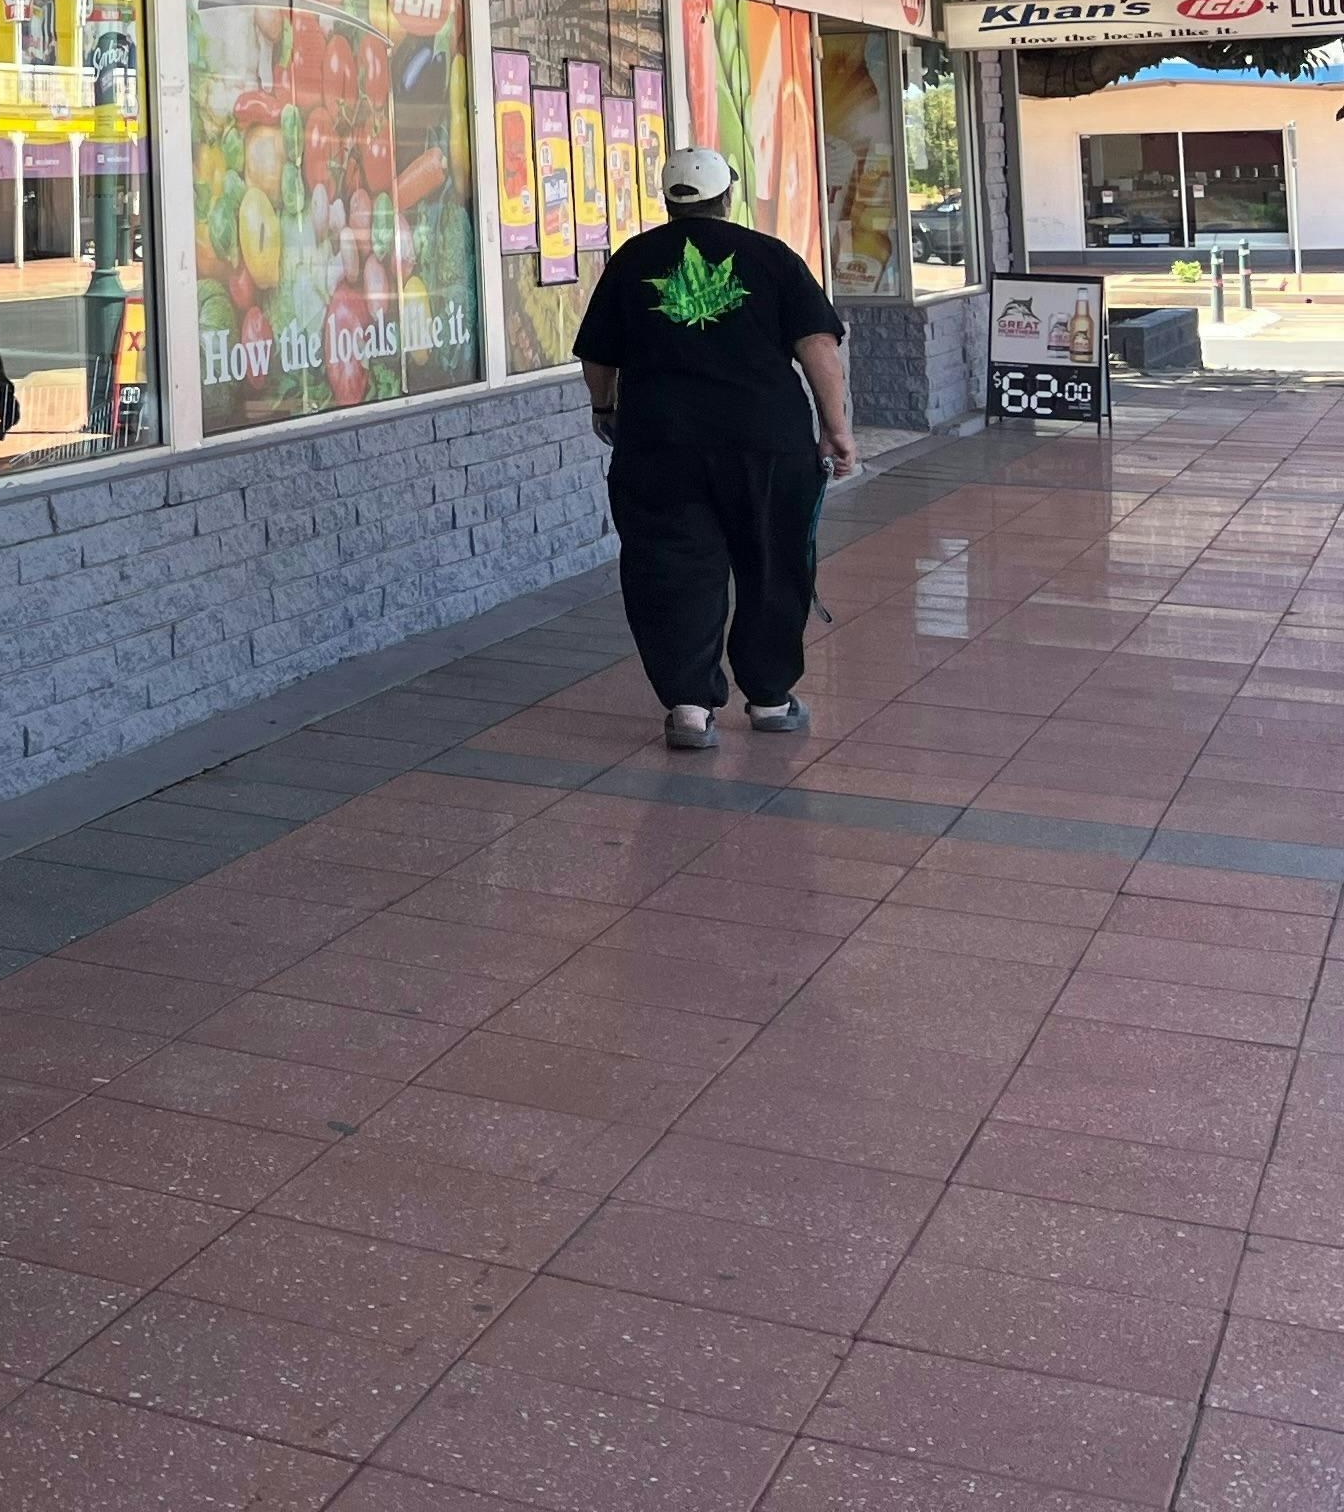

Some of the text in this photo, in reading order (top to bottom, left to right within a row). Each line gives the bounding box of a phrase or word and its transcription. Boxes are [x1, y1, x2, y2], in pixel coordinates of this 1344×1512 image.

[1011, 27, 1238, 45] How the locals like it.
[998, 320, 1039, 329] GREAT
[202, 300, 471, 386] How the locals like it.
